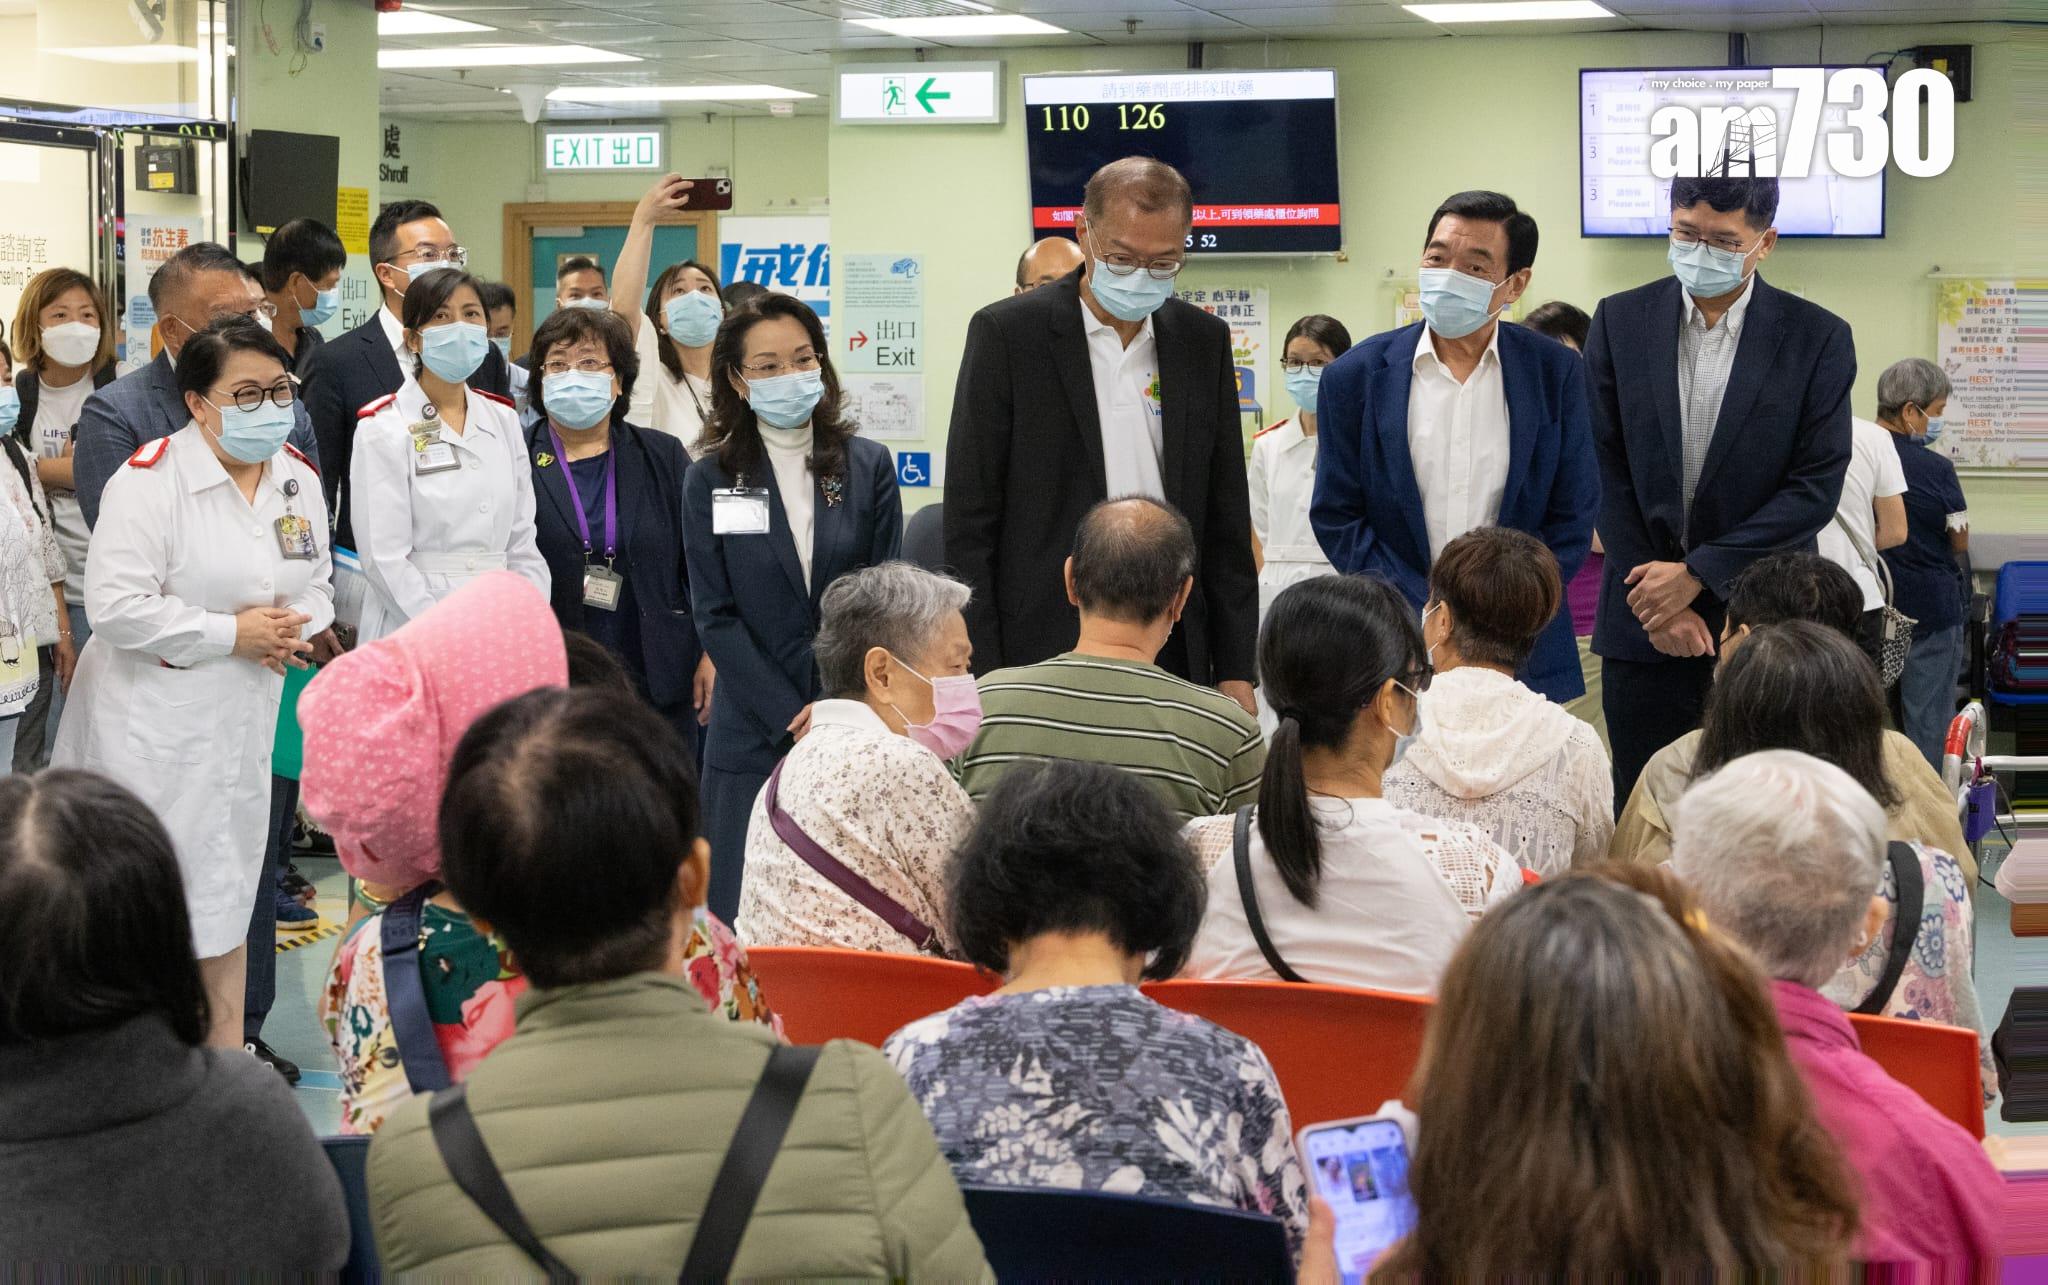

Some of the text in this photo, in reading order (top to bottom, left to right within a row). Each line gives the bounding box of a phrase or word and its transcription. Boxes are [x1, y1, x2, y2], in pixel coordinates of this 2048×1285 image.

[1042, 103, 1166, 131] 110 126
[384, 123, 401, 160] 處
[553, 137, 653, 166] EXIT 出口
[379, 163, 409, 184] Shroff
[153, 227, 189, 248] 抗生素
[1200, 234, 1218, 248] 52
[342, 275, 367, 300] 出口
[1212, 290, 1251, 303] 心平靜
[342, 308, 367, 331] Exit
[876, 319, 916, 341] 出口
[876, 346, 916, 366] Exit
[1968, 375, 1994, 384] REST
[1968, 385, 1999, 393] checking
[1967, 419, 1992, 427] REST
